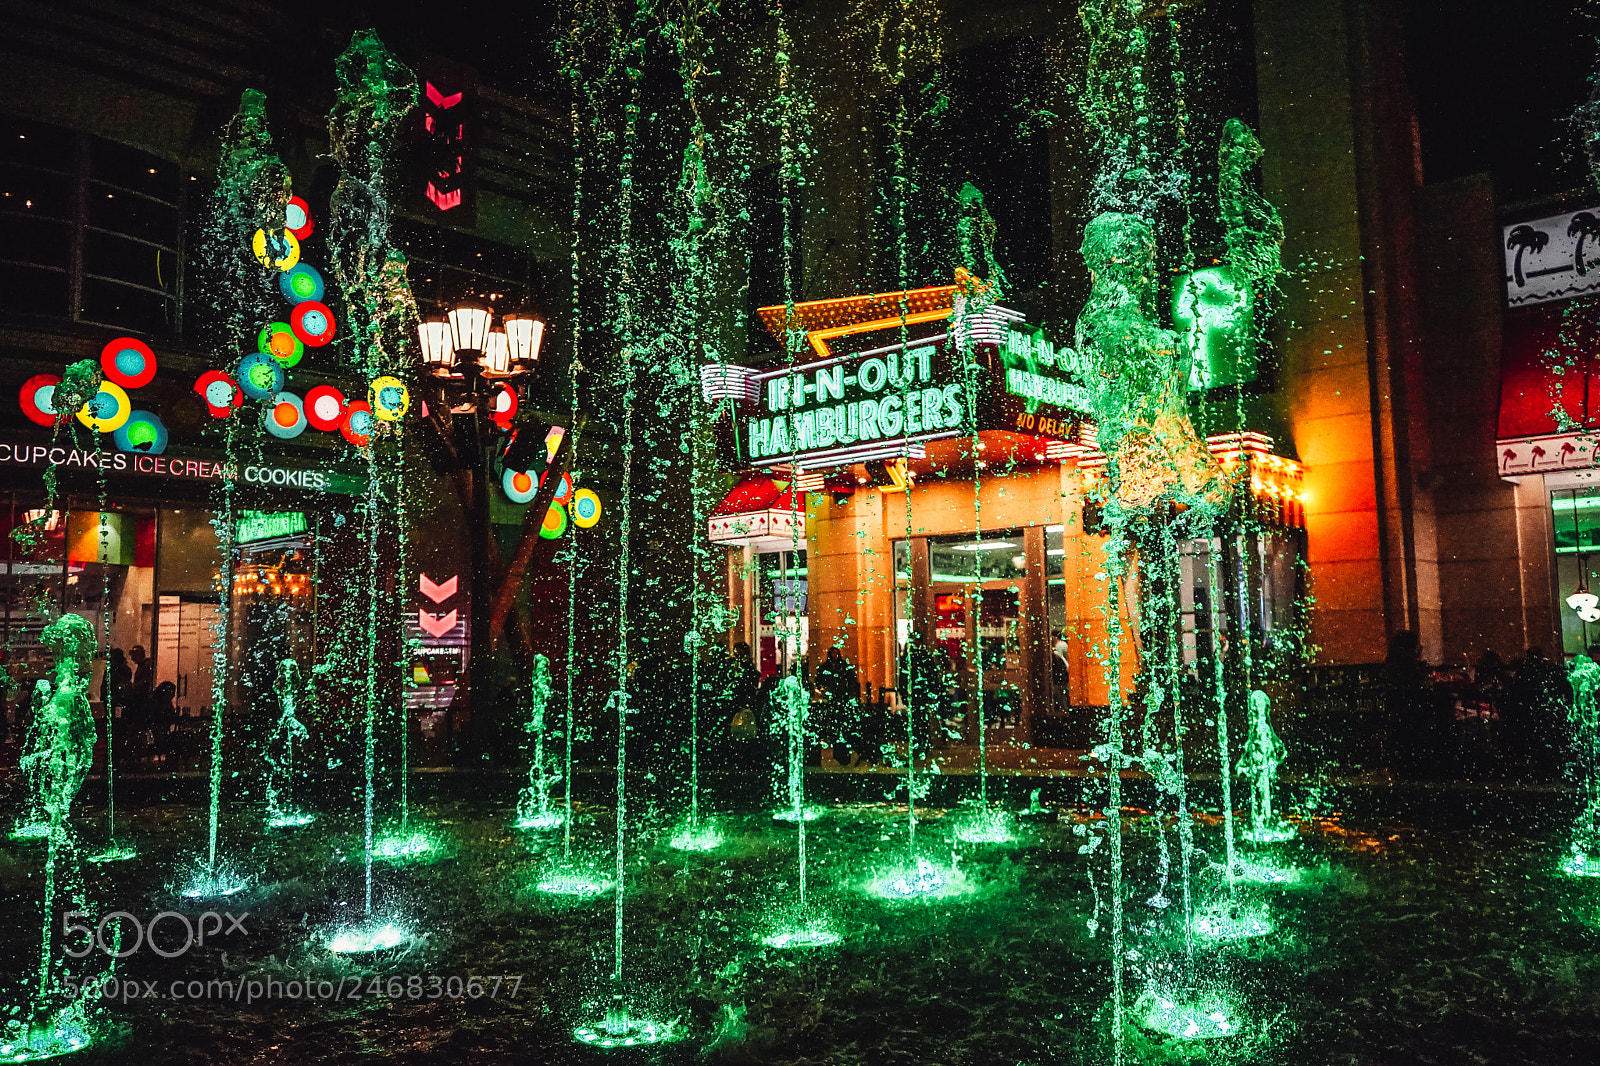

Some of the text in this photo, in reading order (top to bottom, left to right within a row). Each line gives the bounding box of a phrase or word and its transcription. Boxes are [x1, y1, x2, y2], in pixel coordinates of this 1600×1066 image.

[767, 345, 937, 411] IN-N-OUT
[748, 383, 964, 458] HAMBURGERS
[1017, 413, 1072, 436] NO DELAY
[0, 444, 324, 488] CUPCAKES ICE CREAM COOKIES
